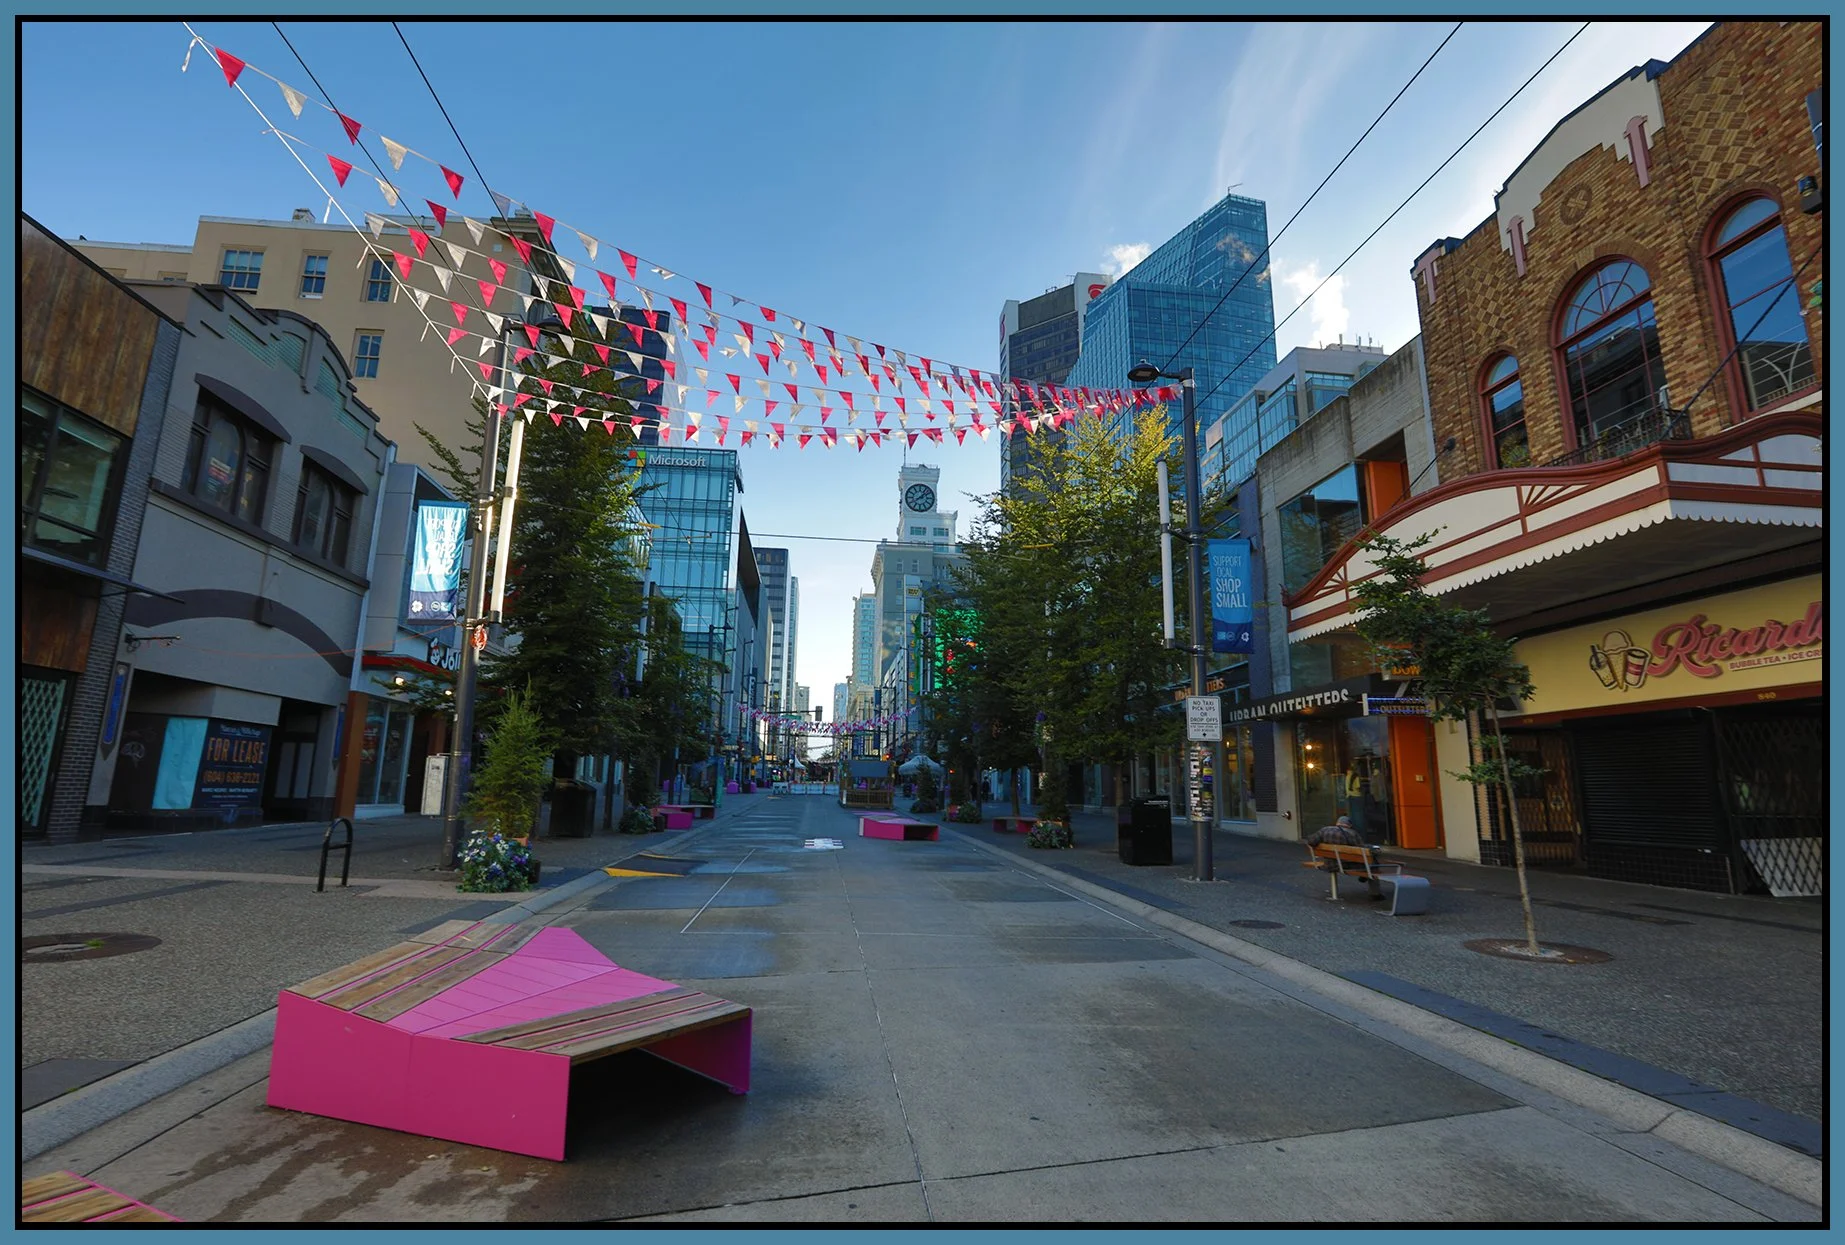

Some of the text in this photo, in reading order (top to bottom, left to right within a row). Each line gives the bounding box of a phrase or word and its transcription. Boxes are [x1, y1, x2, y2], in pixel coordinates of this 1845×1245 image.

[649, 455, 706, 467] Microsoft
[1213, 555, 1242, 567] SUPPORT
[1216, 567, 1233, 578] OCAL
[1216, 578, 1241, 593] SHOP
[1216, 592, 1248, 608] SMALL
[1646, 600, 1822, 677] Ricard
[1730, 649, 1822, 671] BUBBLE TEA ICE CR
[207, 737, 266, 764] FOR LEASE
